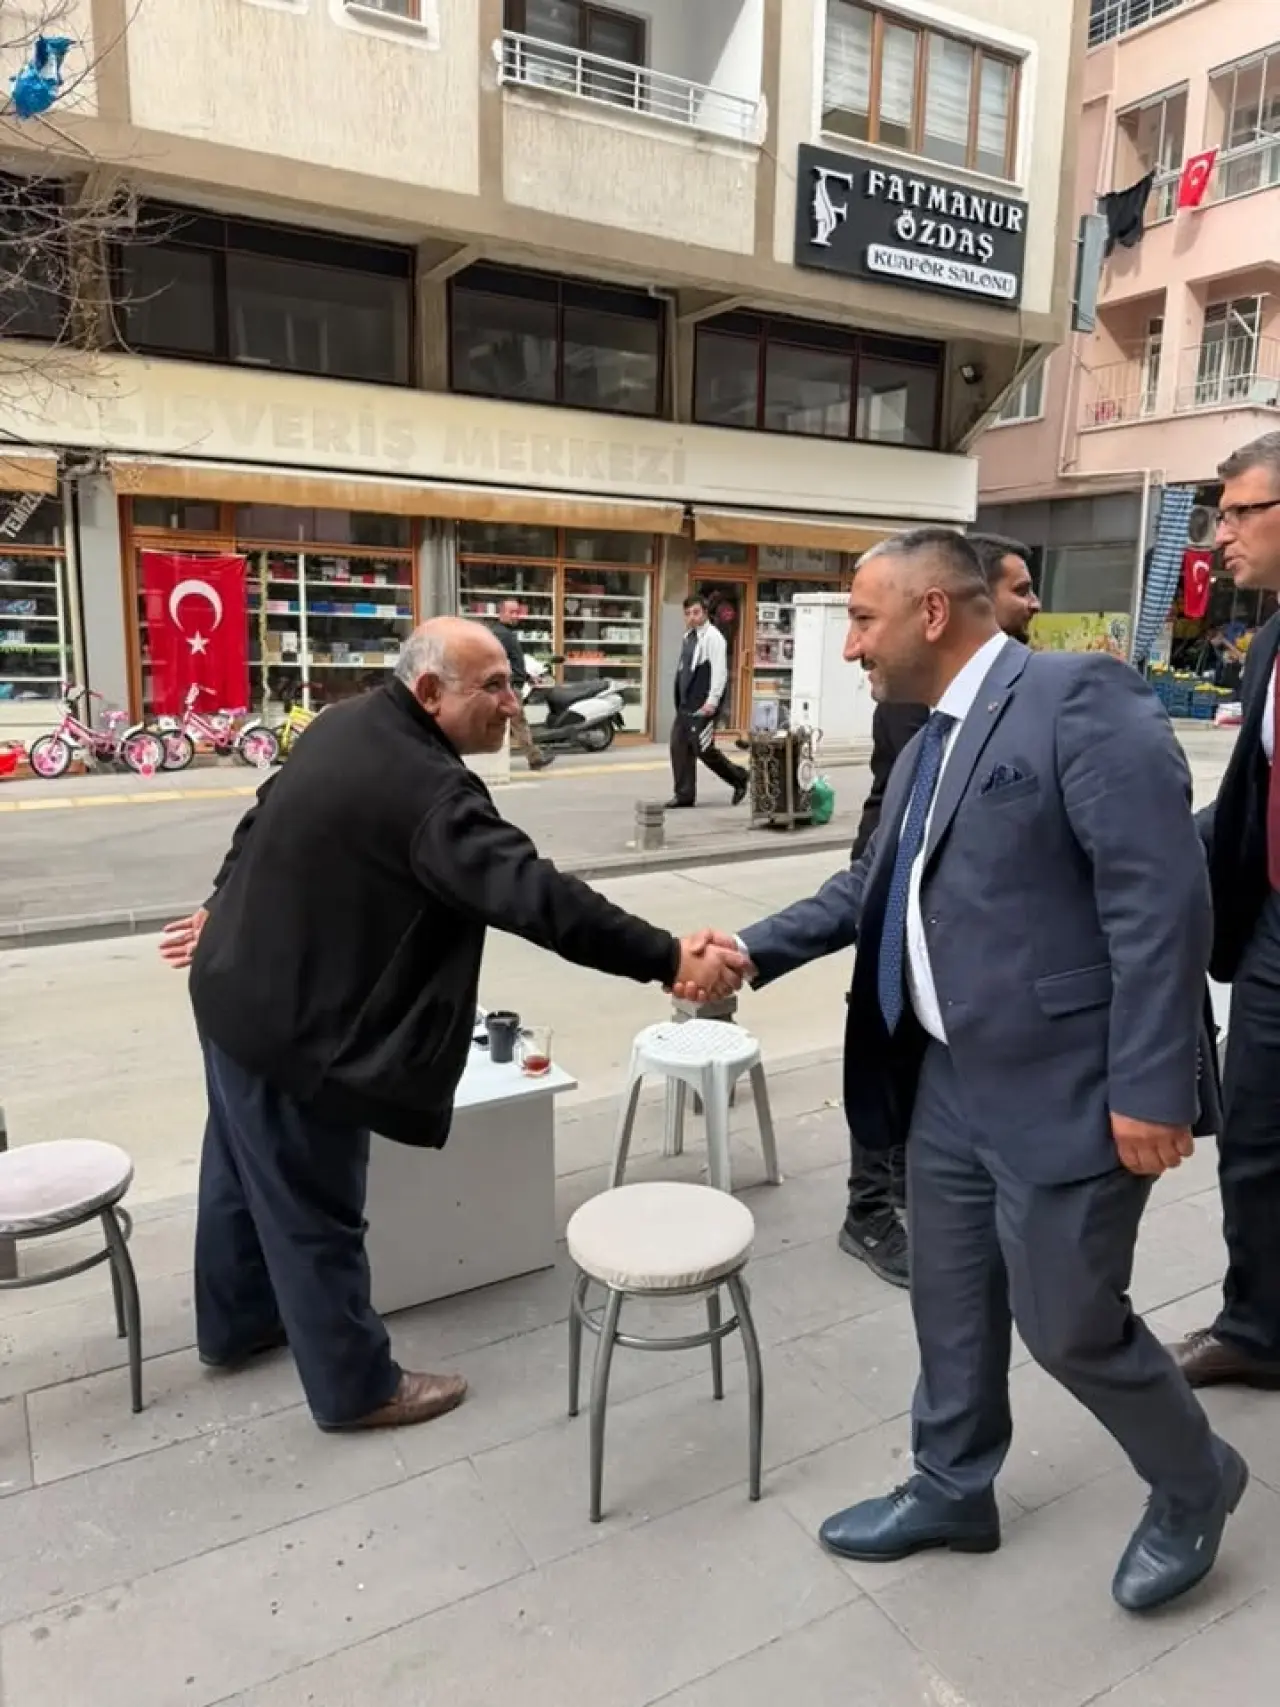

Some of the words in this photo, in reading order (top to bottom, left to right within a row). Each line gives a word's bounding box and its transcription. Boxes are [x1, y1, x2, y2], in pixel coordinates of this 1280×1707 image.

[867, 169, 1023, 232] FATMANUR
[895, 209, 994, 263] ÖZDAŞ
[874, 249, 944, 278] KUAFÖR
[948, 265, 1013, 292] SALONU
[443, 423, 686, 485] MERKEZİ
